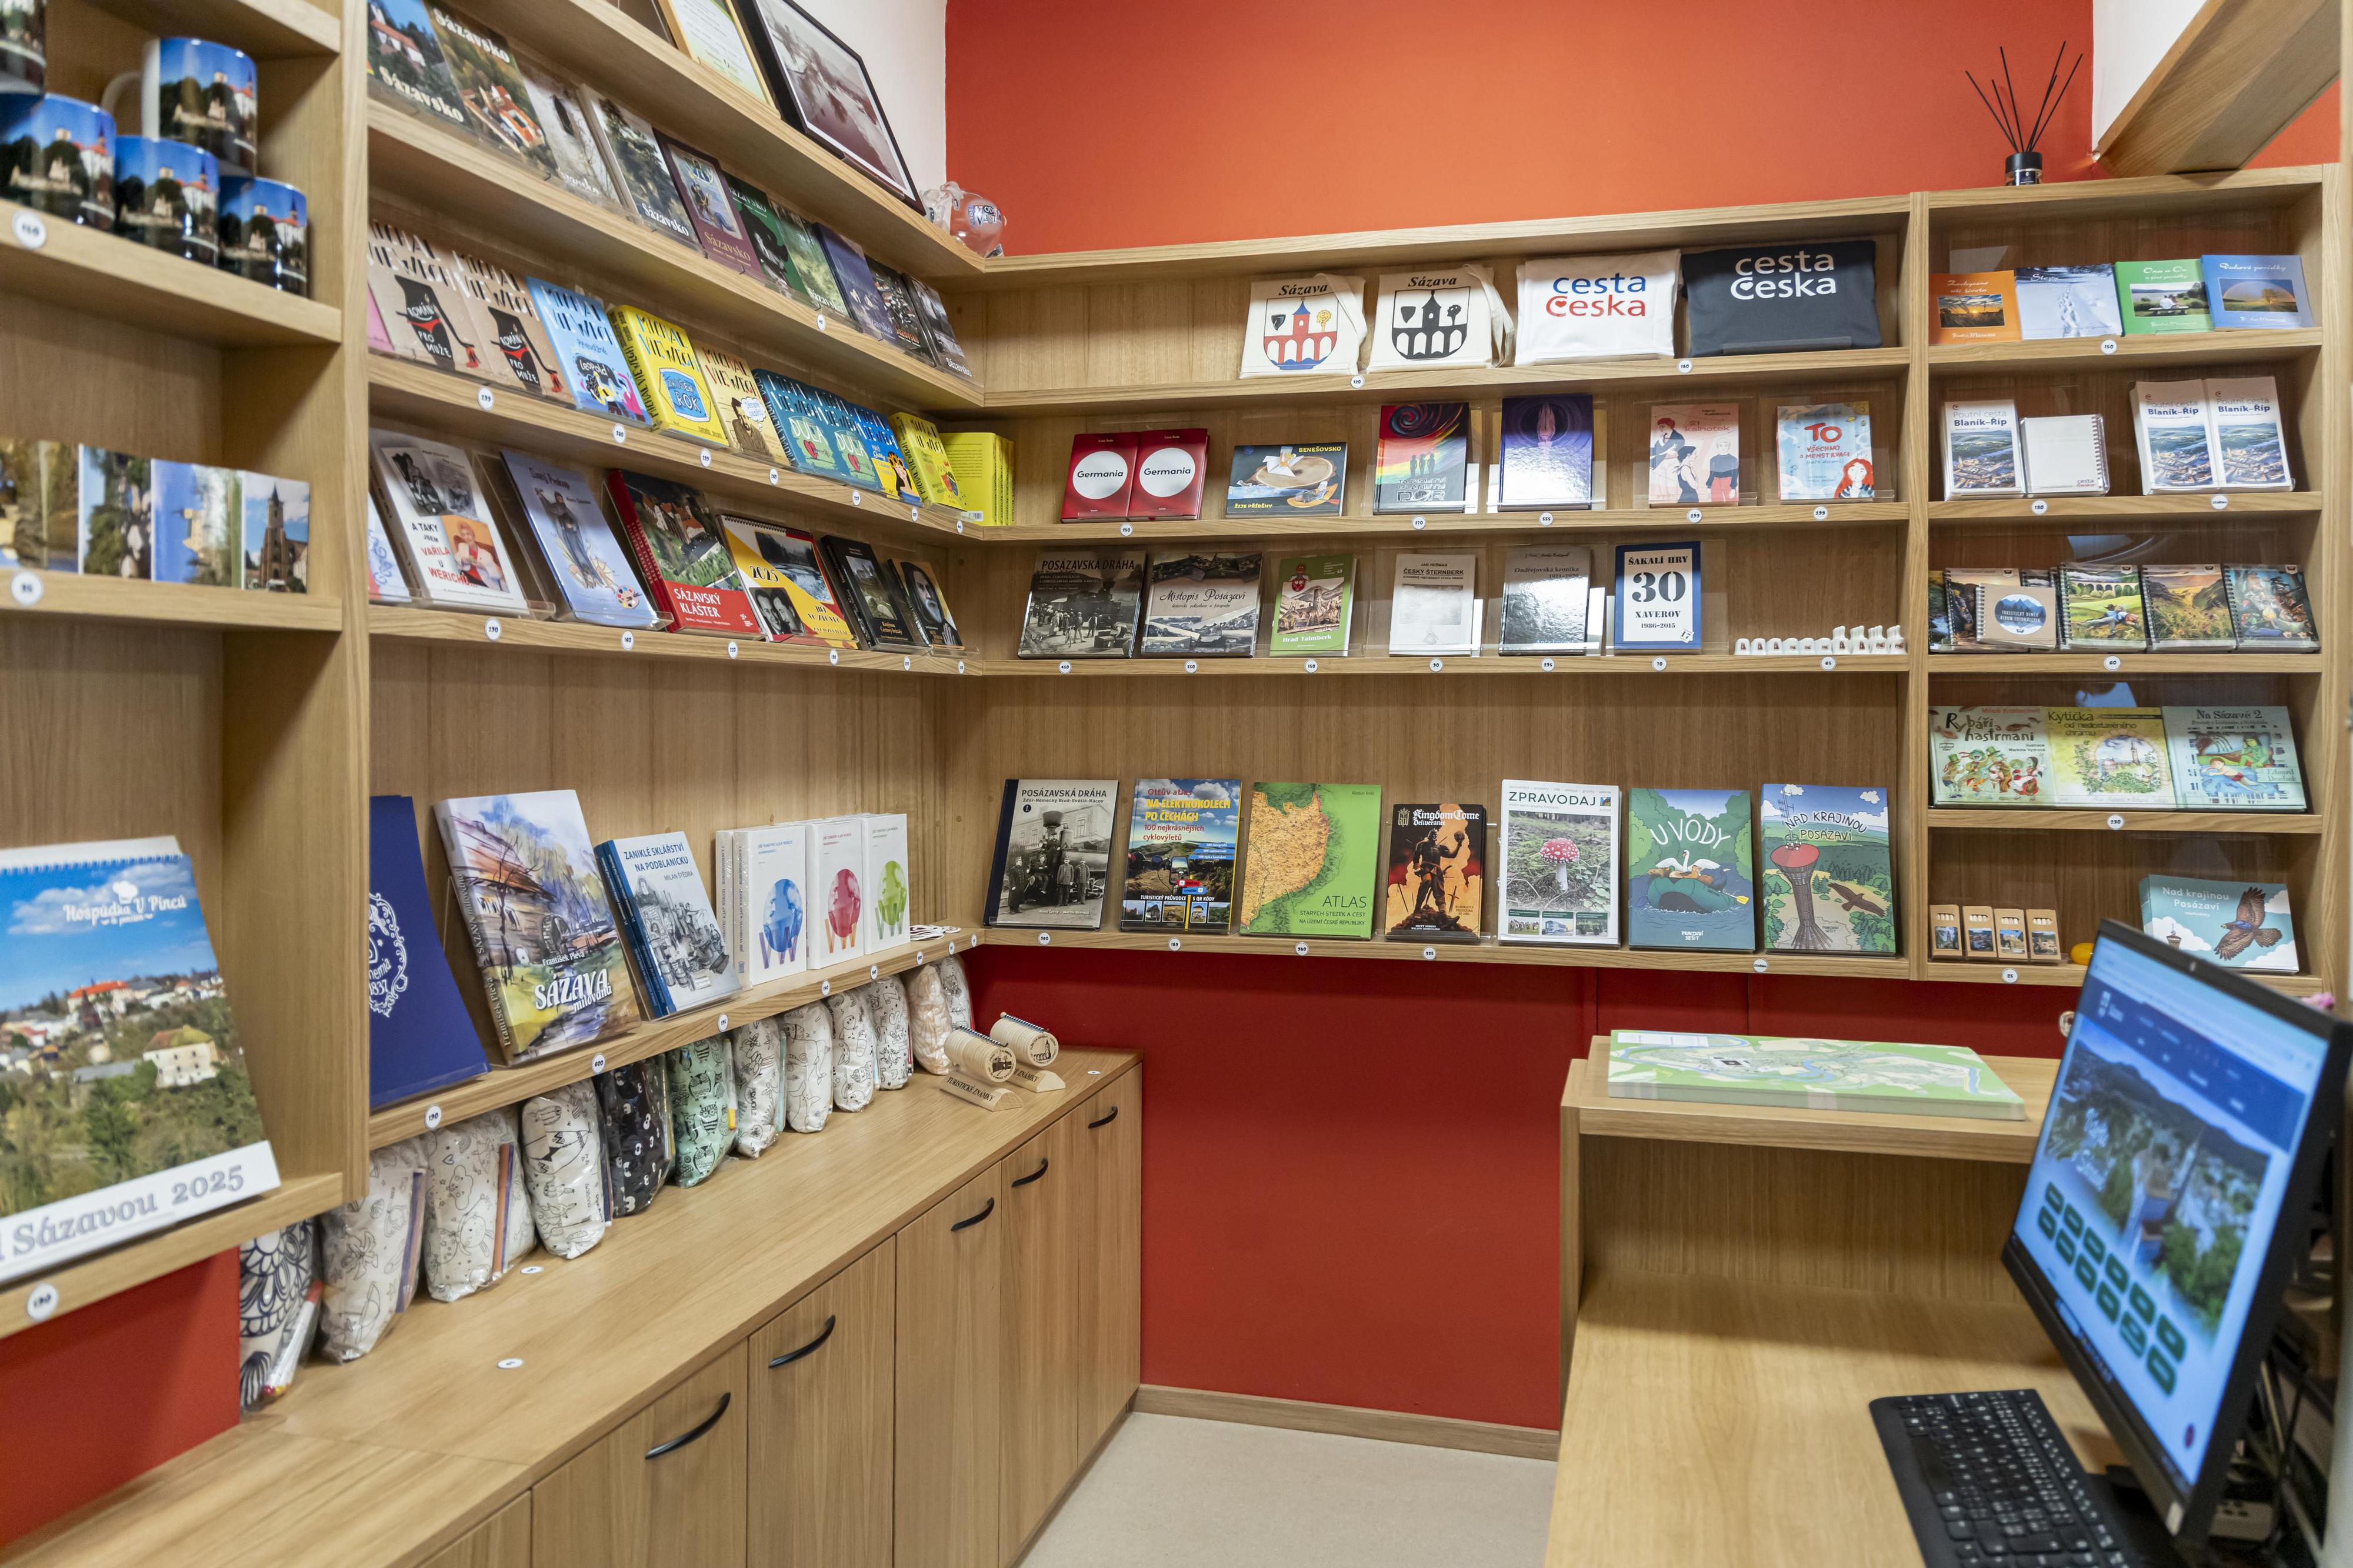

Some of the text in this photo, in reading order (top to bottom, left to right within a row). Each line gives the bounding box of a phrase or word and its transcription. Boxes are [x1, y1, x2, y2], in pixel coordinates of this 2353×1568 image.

[642, 203, 689, 236] Sázavsko
[705, 231, 751, 261] Sázavsko
[1735, 251, 1835, 276] cesta
[1408, 276, 1458, 288] Sázava
[1552, 272, 1647, 294] cesta
[1279, 283, 1329, 296] Sázava
[408, 302, 436, 317] ROMÁN
[418, 330, 434, 343] PRO
[635, 314, 688, 349] MICHAL
[499, 332, 522, 346] ROMÁN
[426, 342, 451, 358] MUŽE
[638, 333, 701, 373] VIEWEGH
[509, 358, 524, 370] PRO
[702, 347, 749, 376] MICHAL
[516, 369, 539, 383] MUŽE
[705, 364, 761, 398] VIEWEGH
[675, 391, 702, 413] ROK
[2217, 396, 2244, 405] Poutní
[1953, 410, 1981, 418] Poutní
[788, 416, 828, 445] DULA
[1804, 422, 1842, 443] TO
[834, 431, 872, 457] DULA
[1077, 469, 1124, 478] Germania
[1144, 466, 1191, 476] Germania
[419, 523, 438, 532] TAKY
[421, 546, 451, 556] VAŘILA
[438, 560, 444, 568] U
[1628, 555, 1688, 566] ŠAKALÍ HRY
[749, 565, 779, 582] 2025
[1632, 571, 1685, 603] 30
[674, 588, 721, 605] SÁZAVSKÝ
[1203, 588, 1247, 603] Posázaví
[679, 602, 721, 618] KLÁŠTER
[1635, 610, 1682, 619] XAVEROV
[2048, 711, 2094, 724] Kytička
[2197, 709, 2262, 719] Na Sázavě 2
[1946, 713, 1993, 732] Rybáři
[1965, 728, 2034, 742] hastrmani
[1021, 788, 1106, 797] POSÁZAVSKÁ DRÁHA
[1148, 788, 1192, 796] Ottův atlas
[1509, 792, 1596, 806] ZPRAVODAJ
[1146, 799, 1231, 809] NA ELEKTROKOLECH
[1145, 809, 1198, 822] PO ČECHÁCH
[1412, 809, 1479, 820] Kingdom Come
[1158, 823, 1204, 833] nejkrásnějších
[1784, 811, 1868, 833] NAD KRAJINOU
[1144, 833, 1182, 842] cyklovýletů
[1651, 819, 1731, 849] U VODY
[1800, 828, 1852, 841] POSÁZAVÍ
[624, 842, 685, 860] ZANIKLÉ SKLÁŘSTVÍ
[635, 856, 689, 872] NA PODBLANICKU
[2162, 887, 2229, 900] Nad krajinou
[134, 896, 145, 913] V
[1322, 896, 1367, 908] ATLAS
[2174, 899, 2220, 910] Posázaví
[457, 873, 511, 1046] František Pleva SÁZAVA milovaná
[542, 951, 585, 966] František Pleva
[535, 969, 608, 1010] SÁZAVA
[573, 985, 613, 1012] milovaná
[1018, 1069, 1040, 1083] ZNÁMKY
[946, 1076, 995, 1102] TURISTICKÉ ZNÁMKY
[13, 1165, 244, 1256] Sázavou 2025
